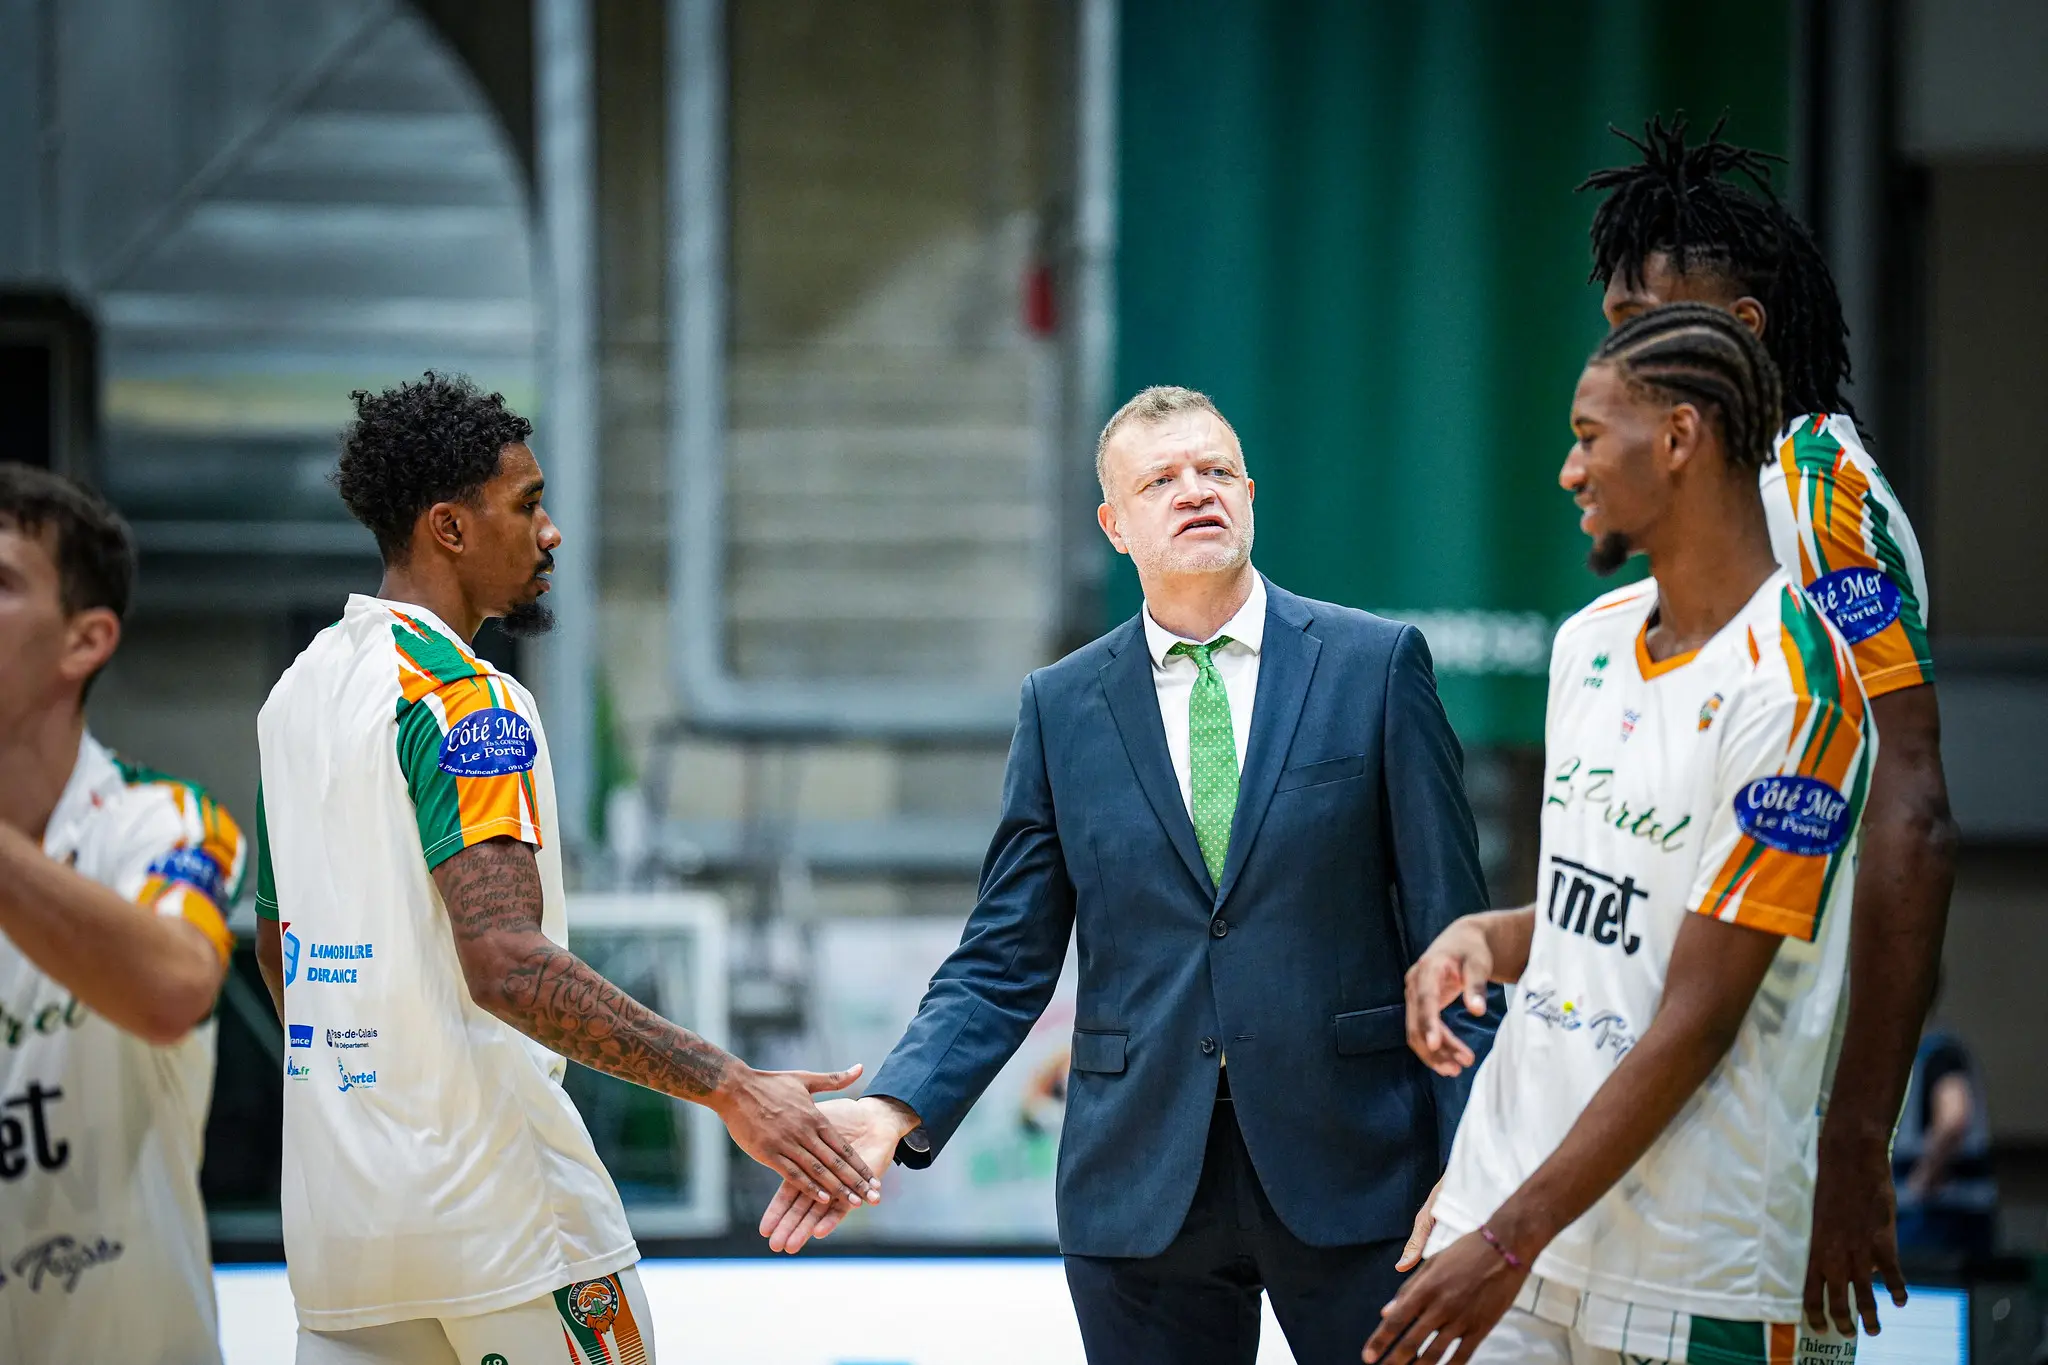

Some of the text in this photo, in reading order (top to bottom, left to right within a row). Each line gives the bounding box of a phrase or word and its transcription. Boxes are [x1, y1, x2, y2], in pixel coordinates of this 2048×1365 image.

[1841, 572, 1882, 605] Mer
[1836, 600, 1884, 628] Portel
[447, 717, 531, 752] Côté Mer
[460, 747, 527, 764] Le Portel
[1747, 778, 1804, 812] Côté
[1755, 812, 1779, 829] Le
[1799, 1336, 1842, 1360] Thierry
